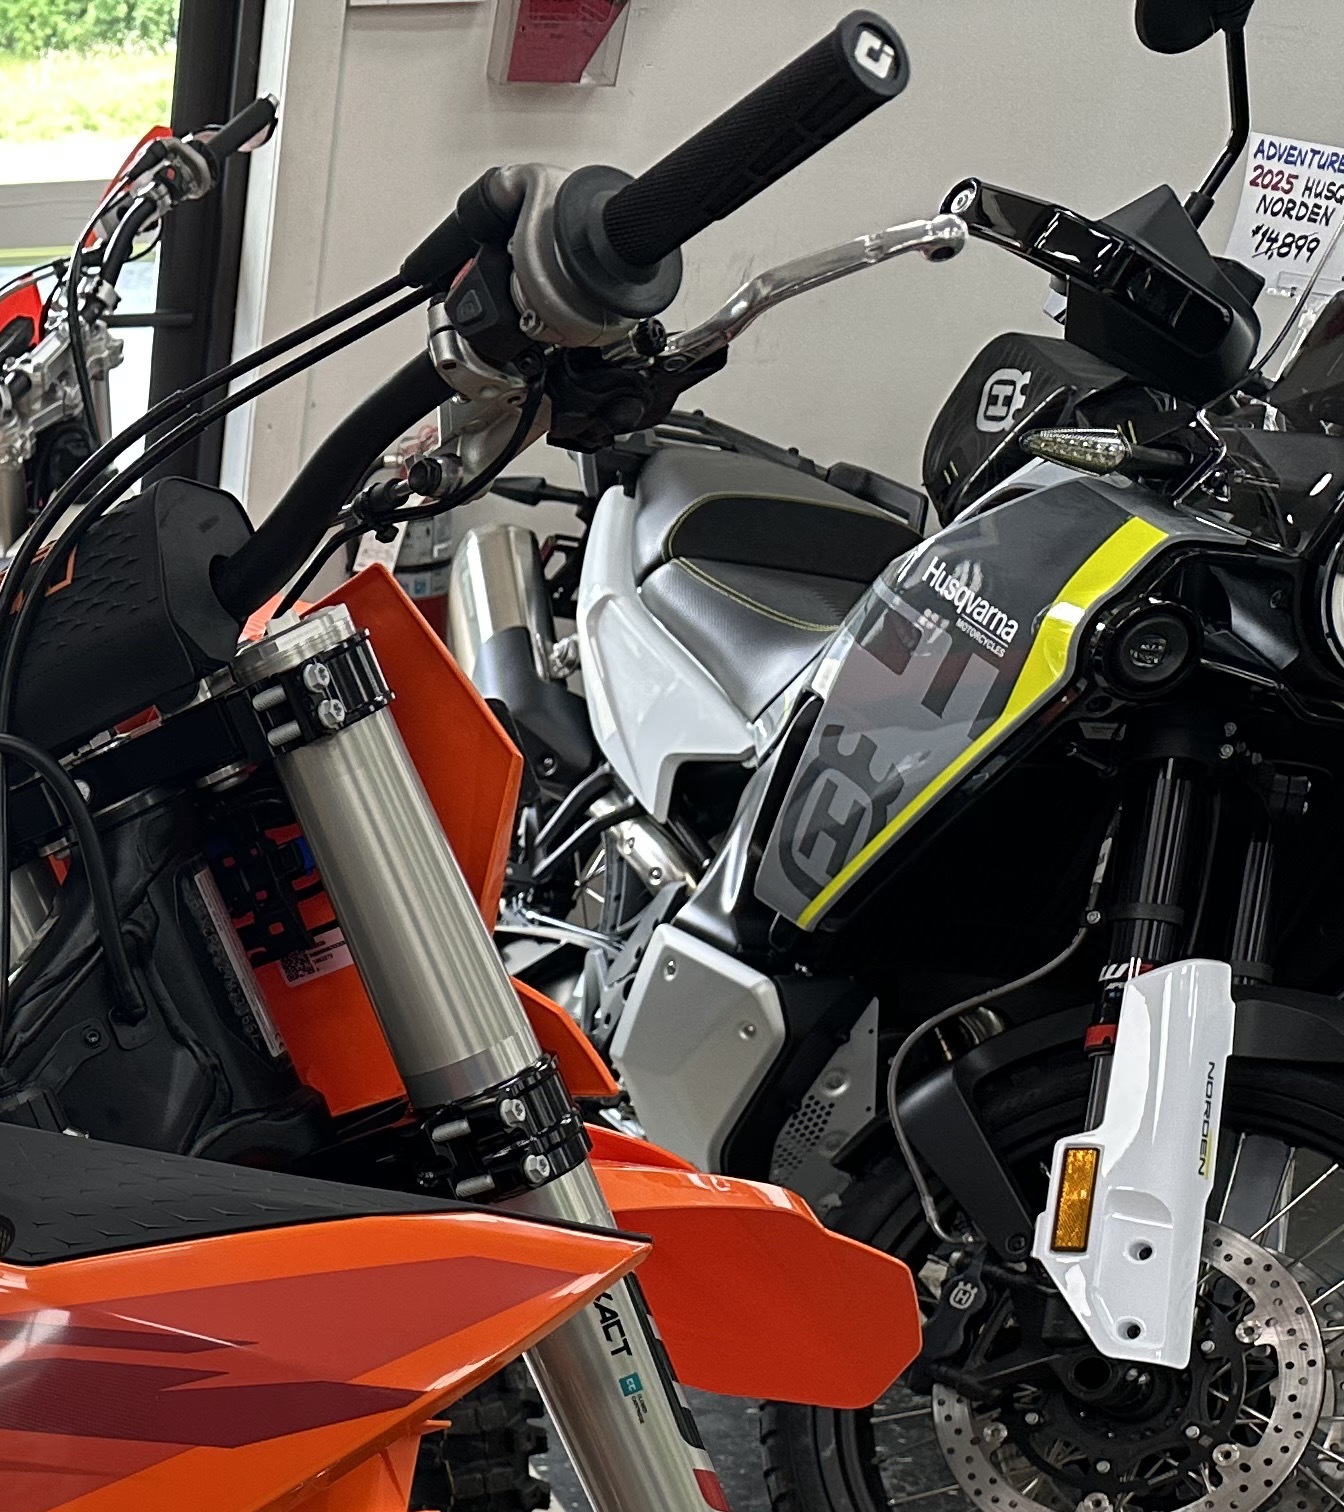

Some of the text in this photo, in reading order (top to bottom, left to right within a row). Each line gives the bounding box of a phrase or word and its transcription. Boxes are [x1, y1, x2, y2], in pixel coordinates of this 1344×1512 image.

[1253, 138, 1344, 174] ADVENTURE
[1249, 164, 1300, 195] 2025
[1255, 193, 1336, 227] NORDEN
[1251, 223, 1321, 263] $14,899
[921, 555, 1019, 643] Husqvarna
[955, 617, 1006, 658] MOTORCYCLES
[1197, 1061, 1216, 1176] NORDEN
